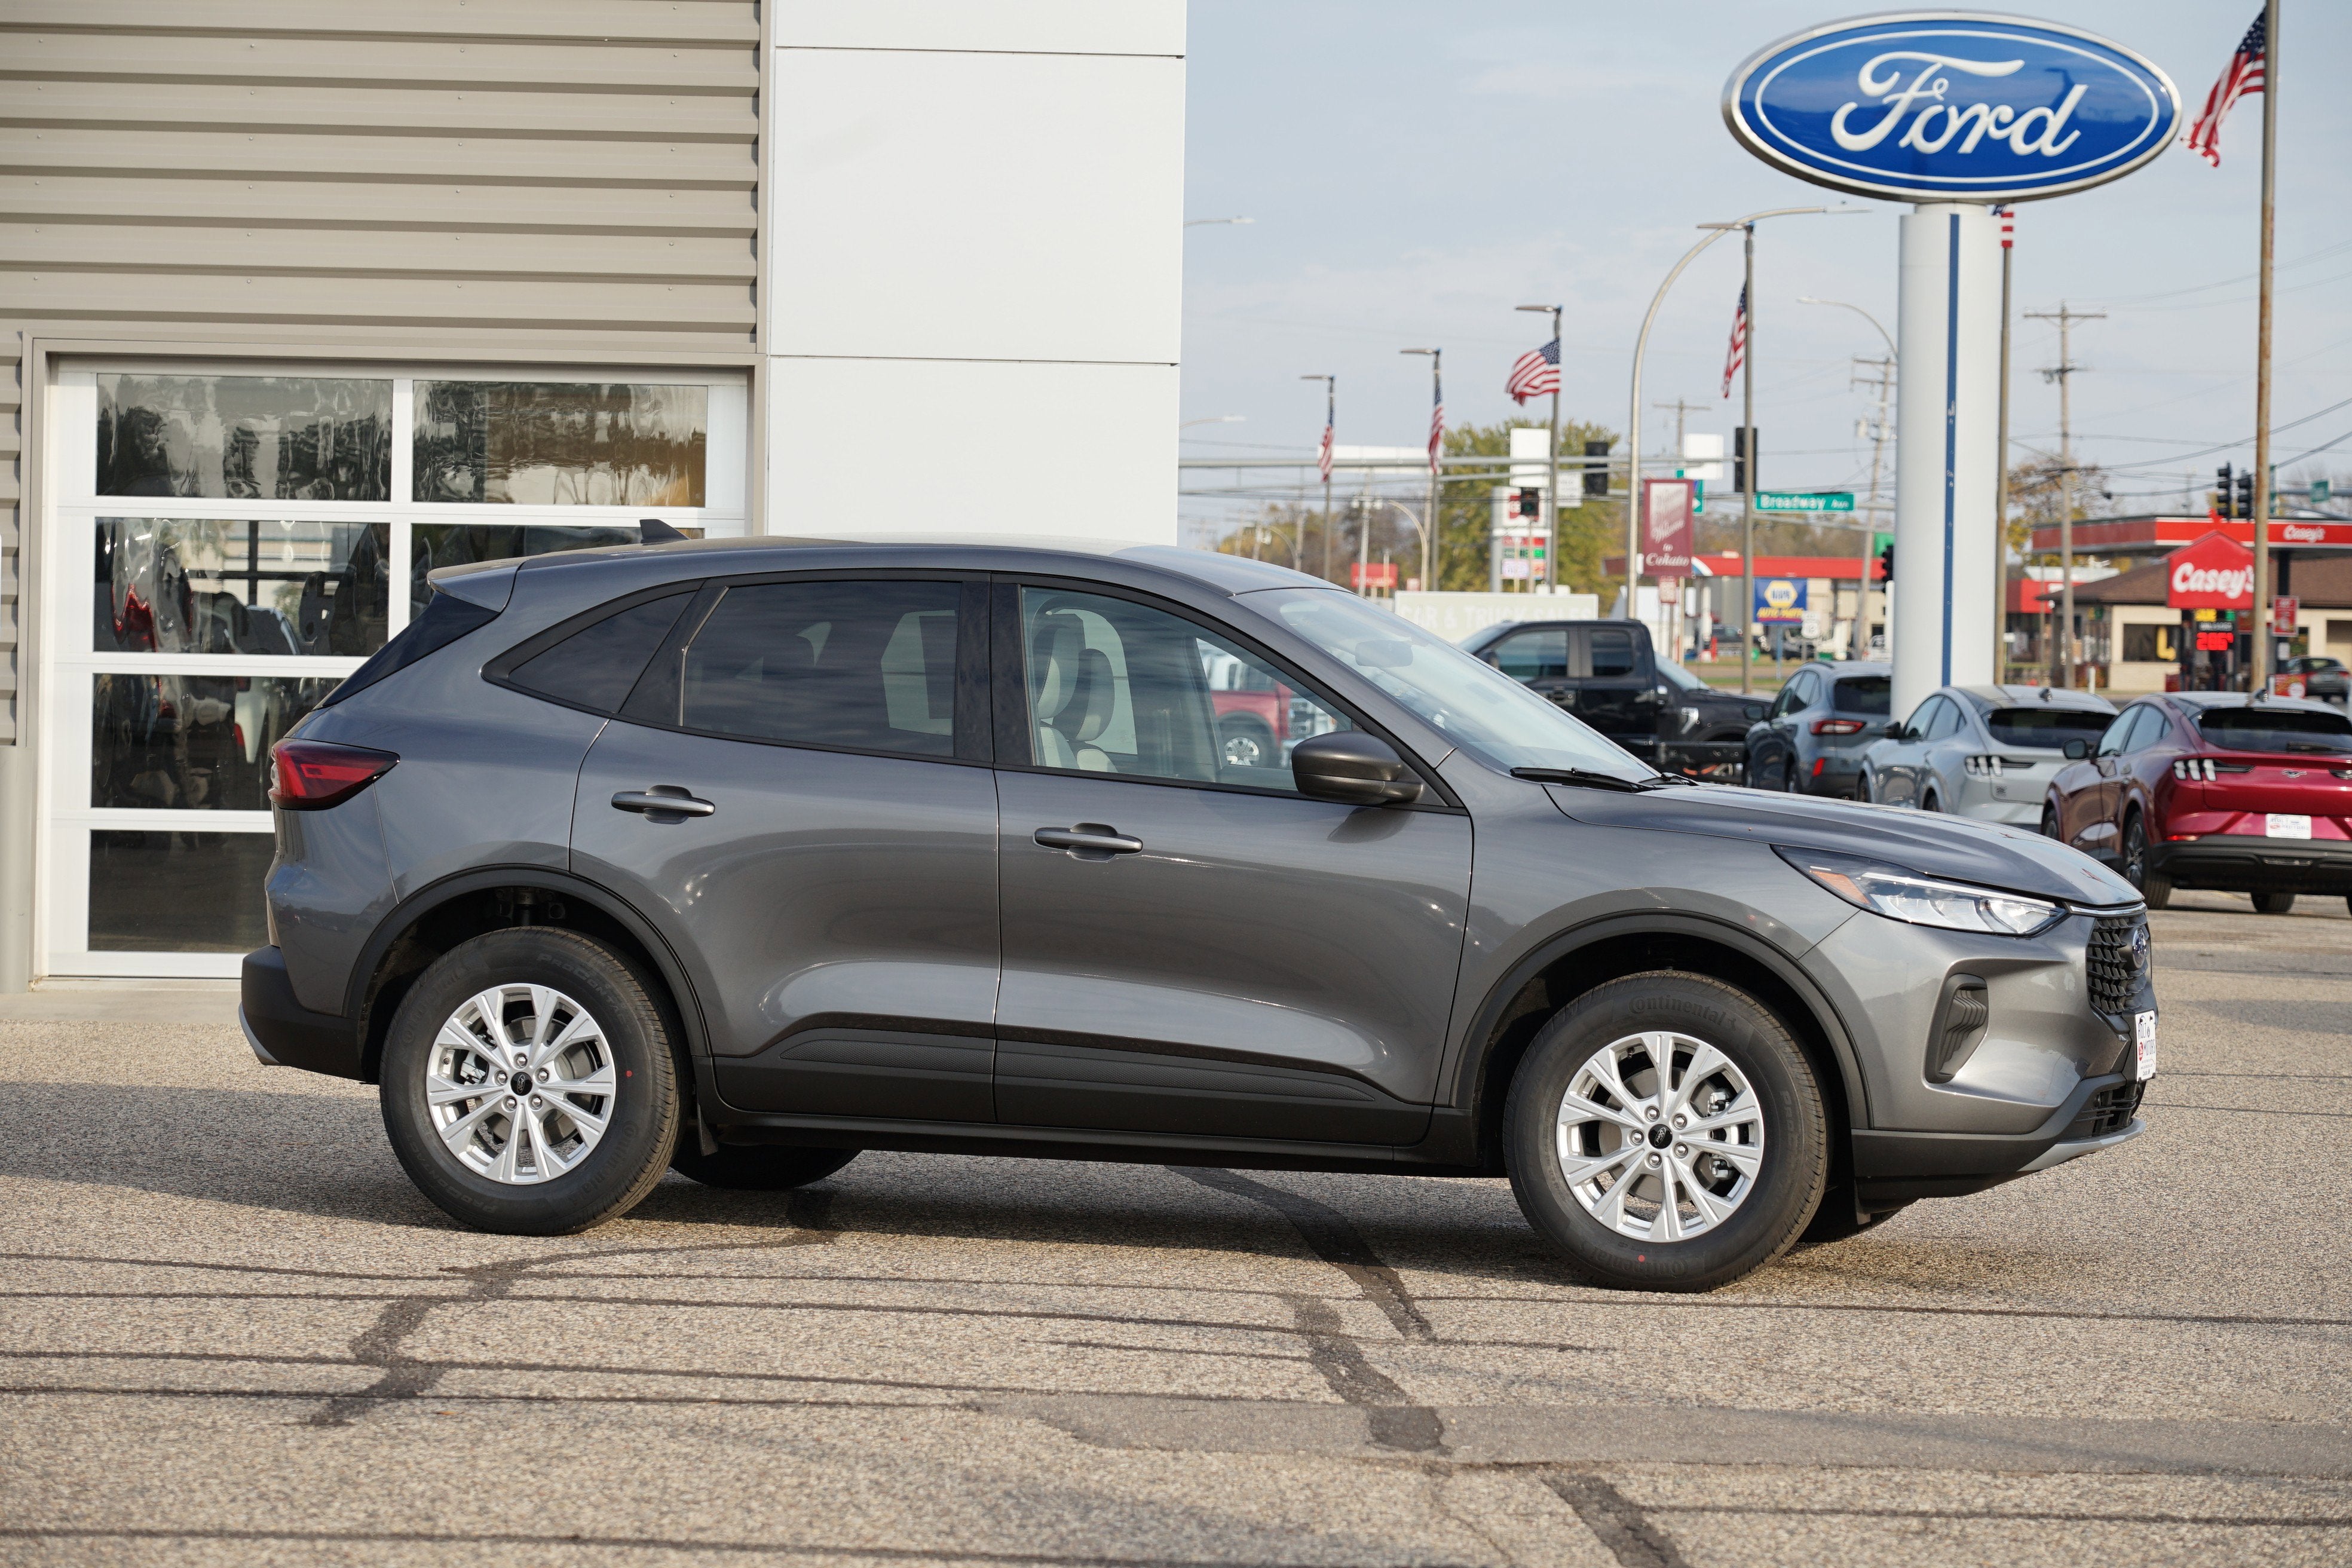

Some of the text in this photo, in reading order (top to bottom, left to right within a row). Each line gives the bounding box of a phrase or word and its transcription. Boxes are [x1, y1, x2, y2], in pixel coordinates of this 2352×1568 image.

[1830, 51, 2089, 157] Ford
[1760, 494, 1826, 510] Broadway
[2284, 525, 2325, 543] Casey's
[1628, 994, 1727, 1026] Continental
